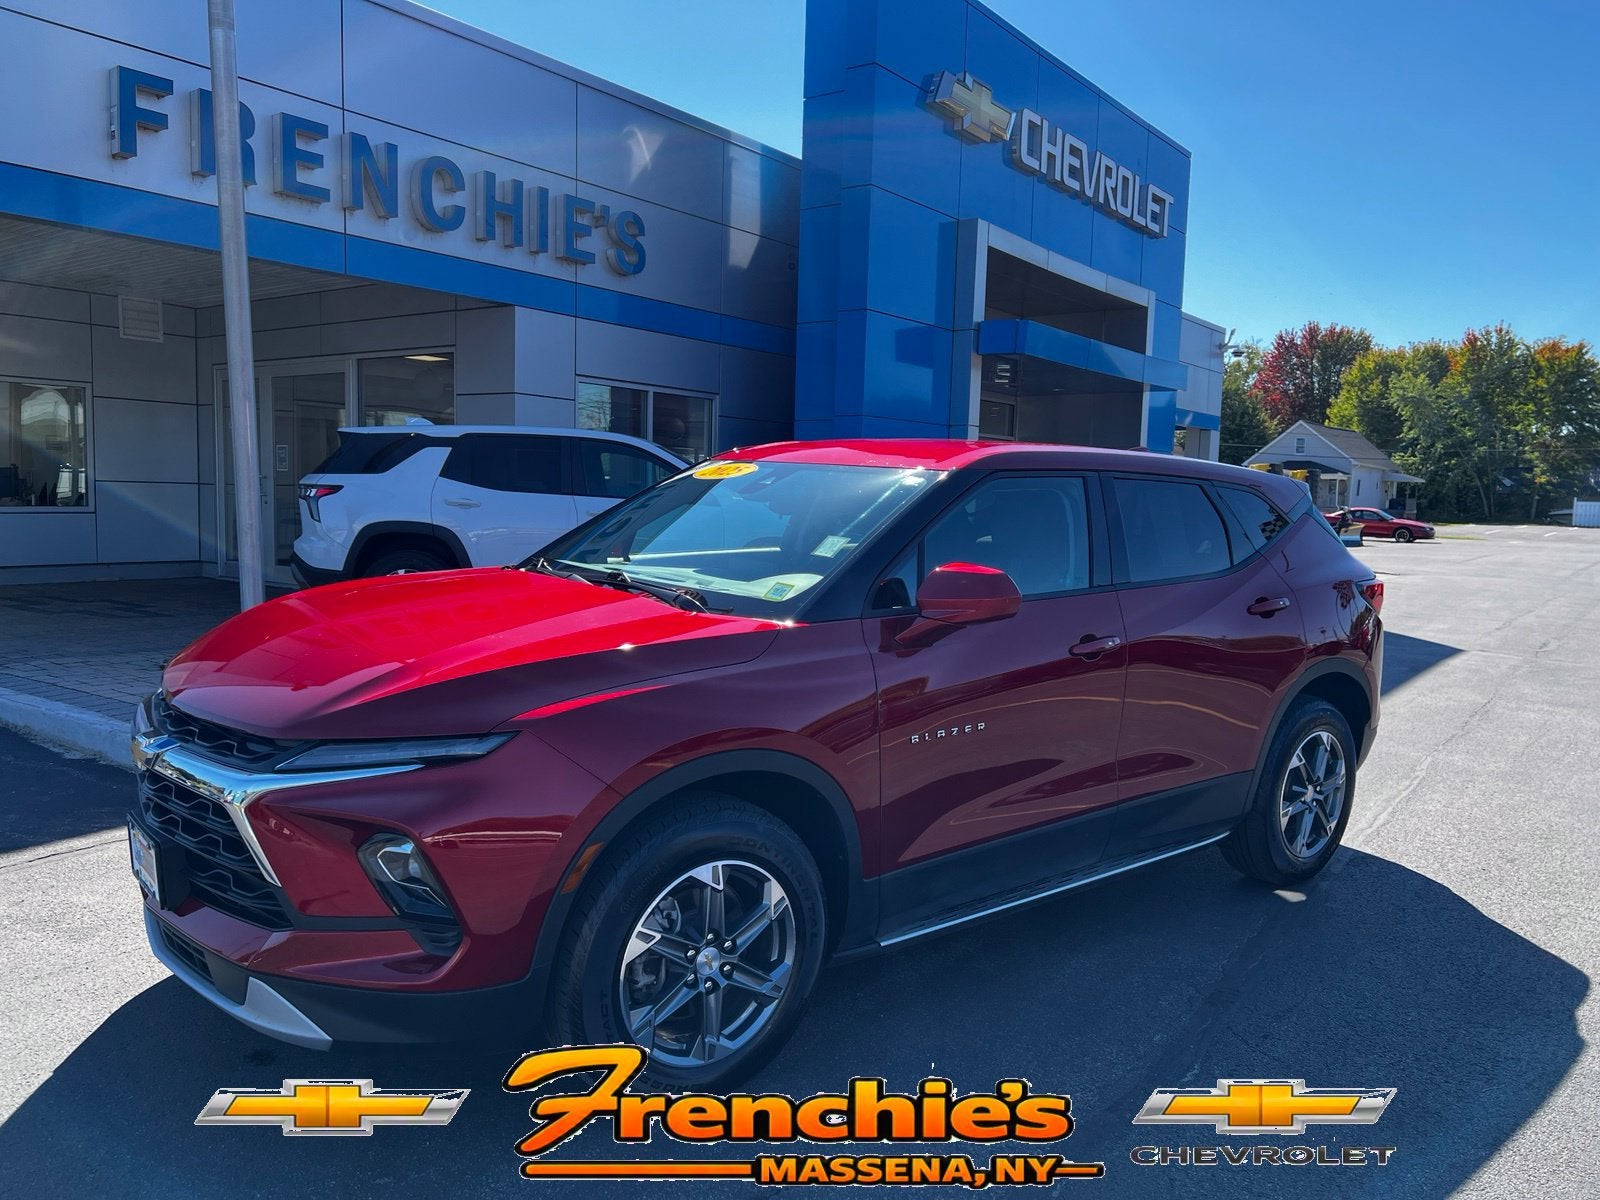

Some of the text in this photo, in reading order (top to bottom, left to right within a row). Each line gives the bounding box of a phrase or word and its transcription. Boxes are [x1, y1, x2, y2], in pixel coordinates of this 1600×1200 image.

[109, 65, 646, 276] FRENCHIE'S
[1015, 107, 1175, 239] CHEVROLET
[910, 721, 988, 745] BLAZER
